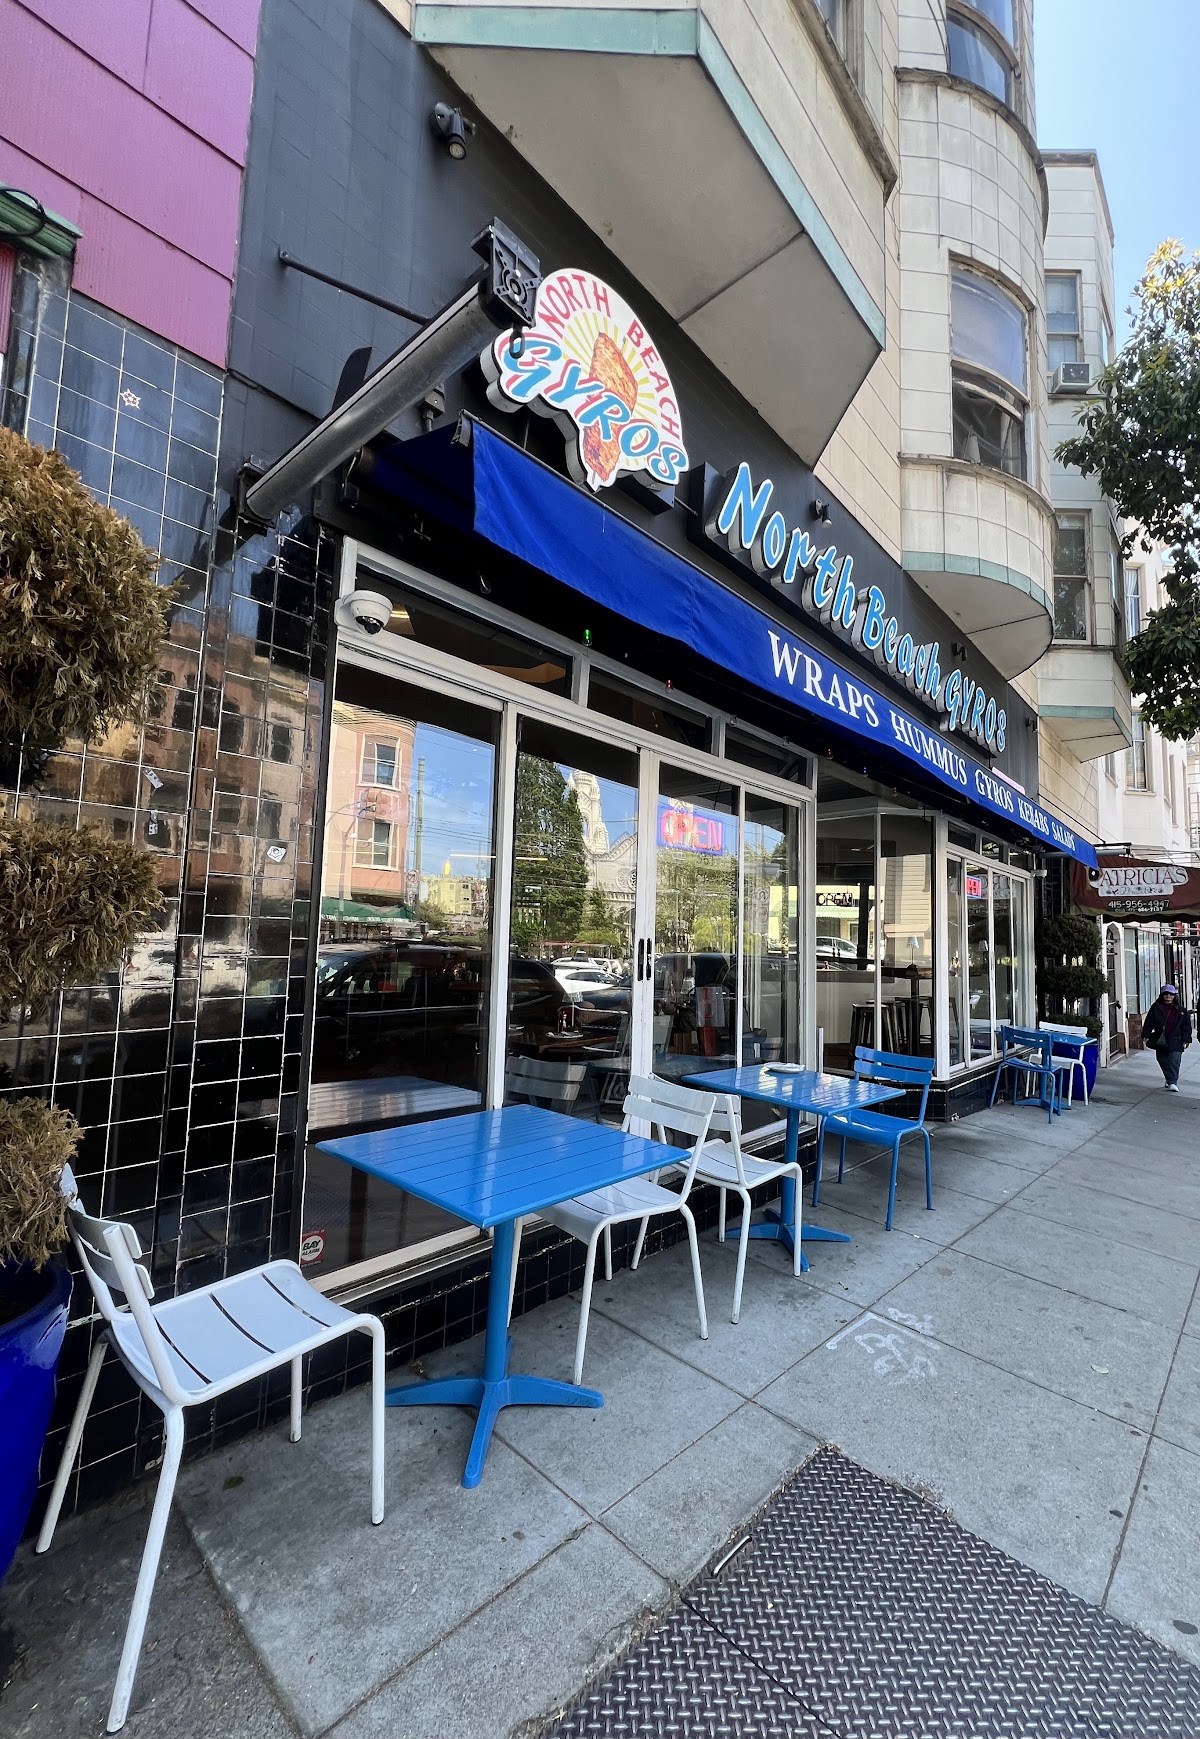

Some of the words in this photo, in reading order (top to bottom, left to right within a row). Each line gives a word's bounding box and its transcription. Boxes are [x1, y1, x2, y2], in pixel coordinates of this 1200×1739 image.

[499, 334, 688, 481] GYROS
[537, 273, 612, 339] NORTH
[626, 319, 681, 440] BEACH
[717, 461, 857, 629] North
[862, 585, 942, 700] Beach
[945, 669, 1007, 752] GYROS
[767, 629, 880, 728] WRAPS
[889, 709, 968, 786] HUMMUS
[974, 768, 1014, 813] GYROS
[1017, 797, 1050, 836] KEBABS
[1051, 821, 1076, 851] SALADS
[661, 809, 723, 852] OPEN
[1099, 867, 1187, 887] ATRICIA'S
[302, 1239, 321, 1251] BAY
